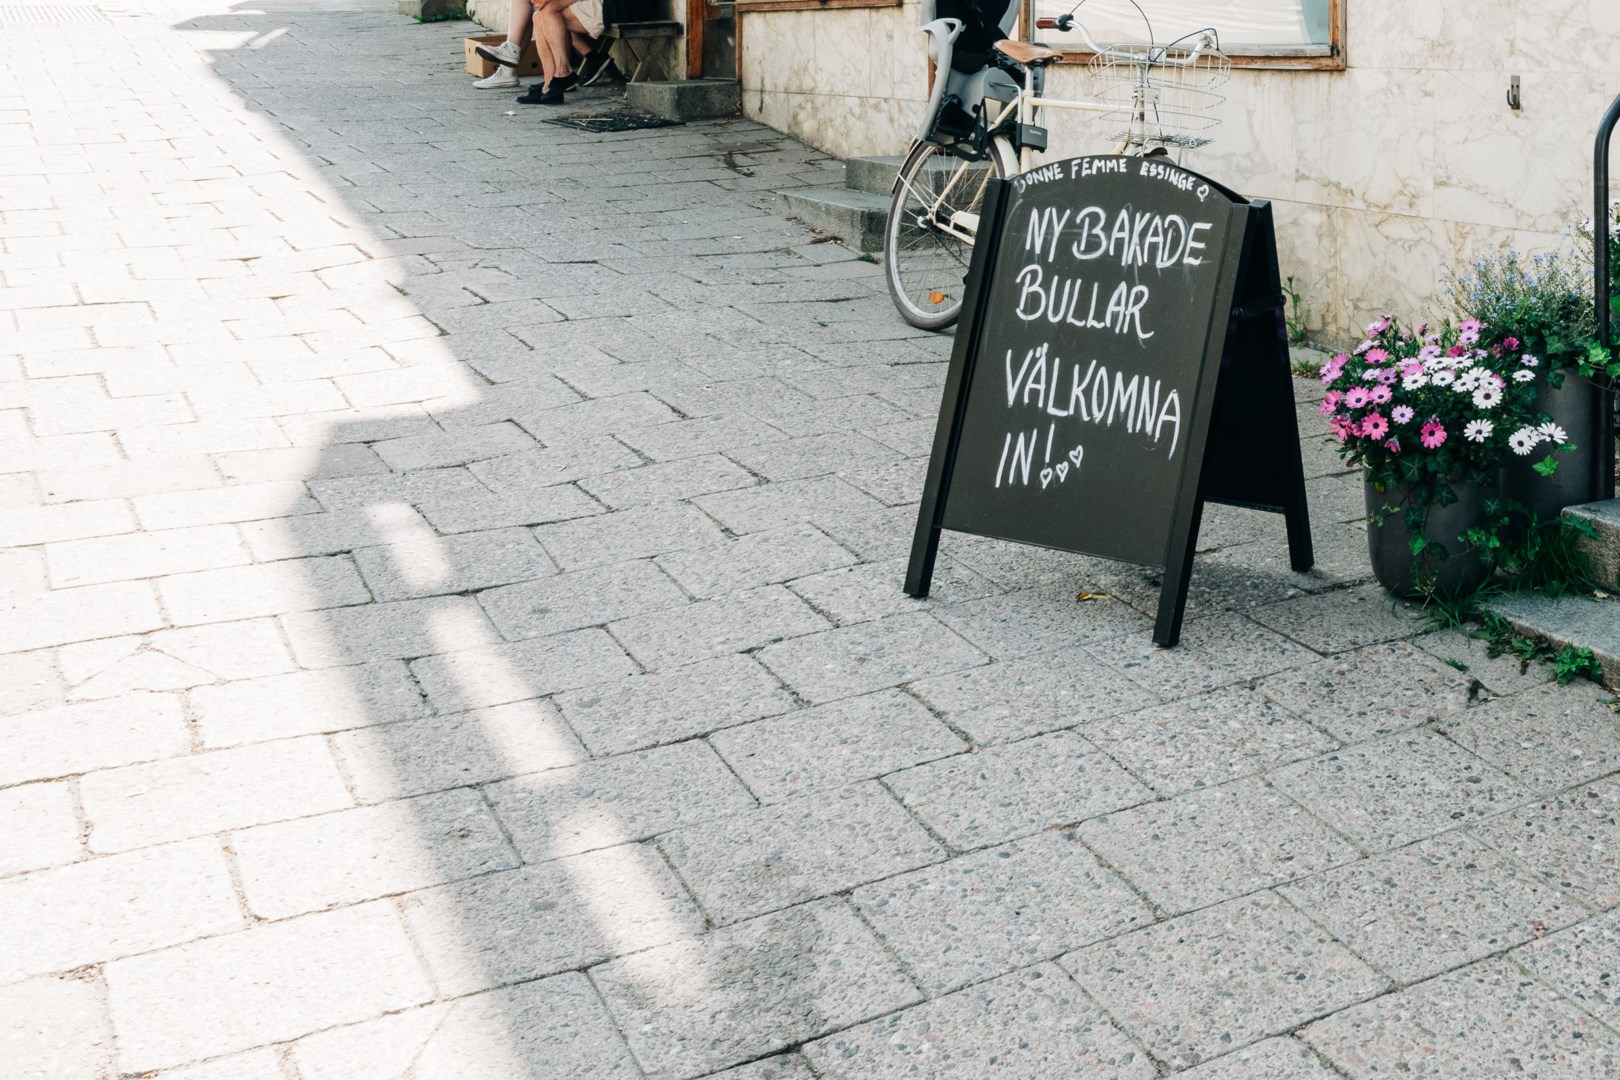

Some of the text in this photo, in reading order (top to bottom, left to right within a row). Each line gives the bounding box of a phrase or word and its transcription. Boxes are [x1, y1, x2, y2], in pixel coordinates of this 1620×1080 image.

[1071, 158, 1128, 179] FEMME
[1139, 161, 1197, 191] ESSINGE
[1025, 206, 1213, 269] NY BAKADE
[1015, 264, 1155, 340] BULLAR
[1007, 342, 1182, 461] VÄLKOMNA
